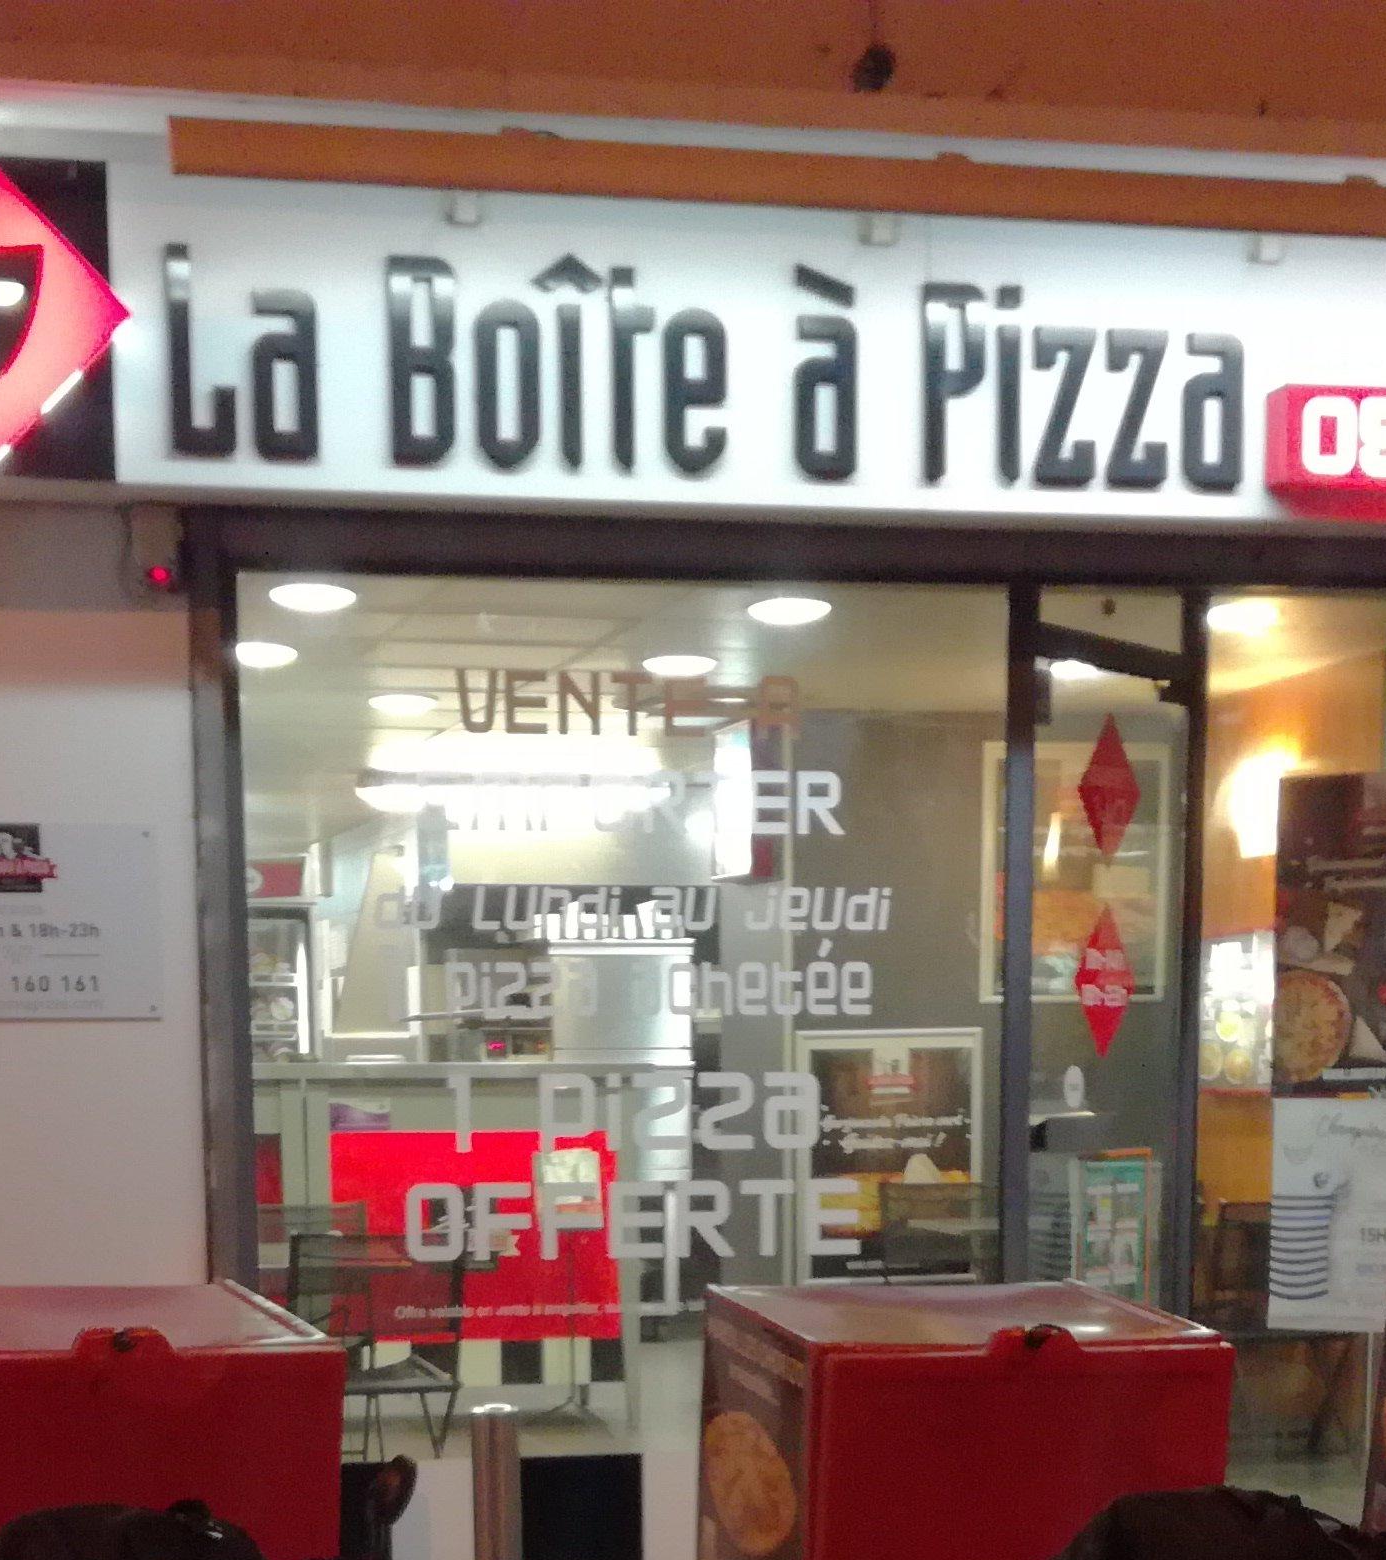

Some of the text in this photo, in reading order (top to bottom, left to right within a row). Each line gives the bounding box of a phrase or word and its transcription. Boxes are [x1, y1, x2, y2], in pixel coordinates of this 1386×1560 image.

[165, 242, 1245, 495] La Boîte à Pizza
[456, 668, 706, 737] VENTE
[11, 975, 51, 993] 160
[61, 975, 101, 993] 161
[405, 1178, 862, 1262] OFFERTE
